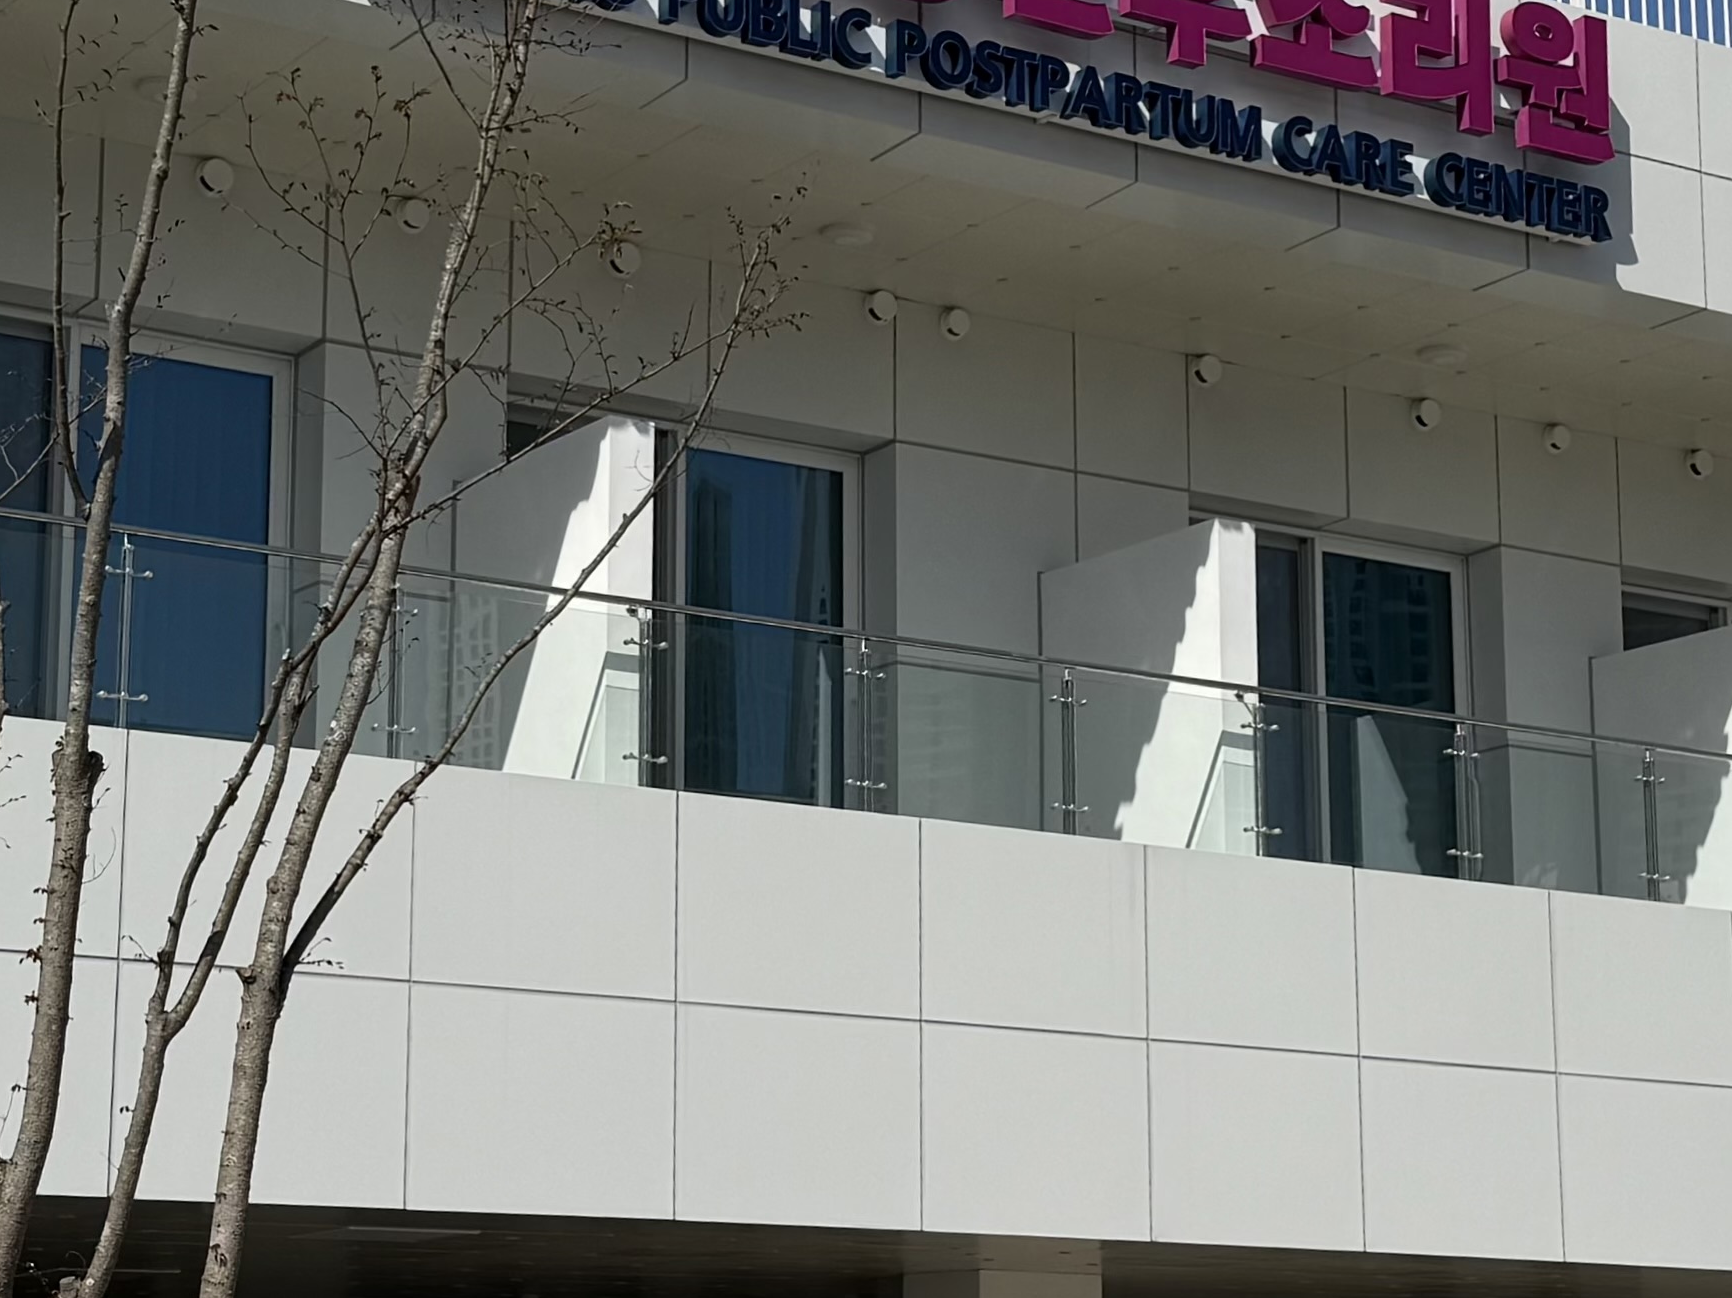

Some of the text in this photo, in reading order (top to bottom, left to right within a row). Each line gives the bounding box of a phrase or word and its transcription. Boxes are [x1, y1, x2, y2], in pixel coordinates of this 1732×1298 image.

[884, 17, 1264, 163] POSTPARTUM
[1272, 115, 1416, 197] CARE
[1423, 150, 1614, 243] CENTER
